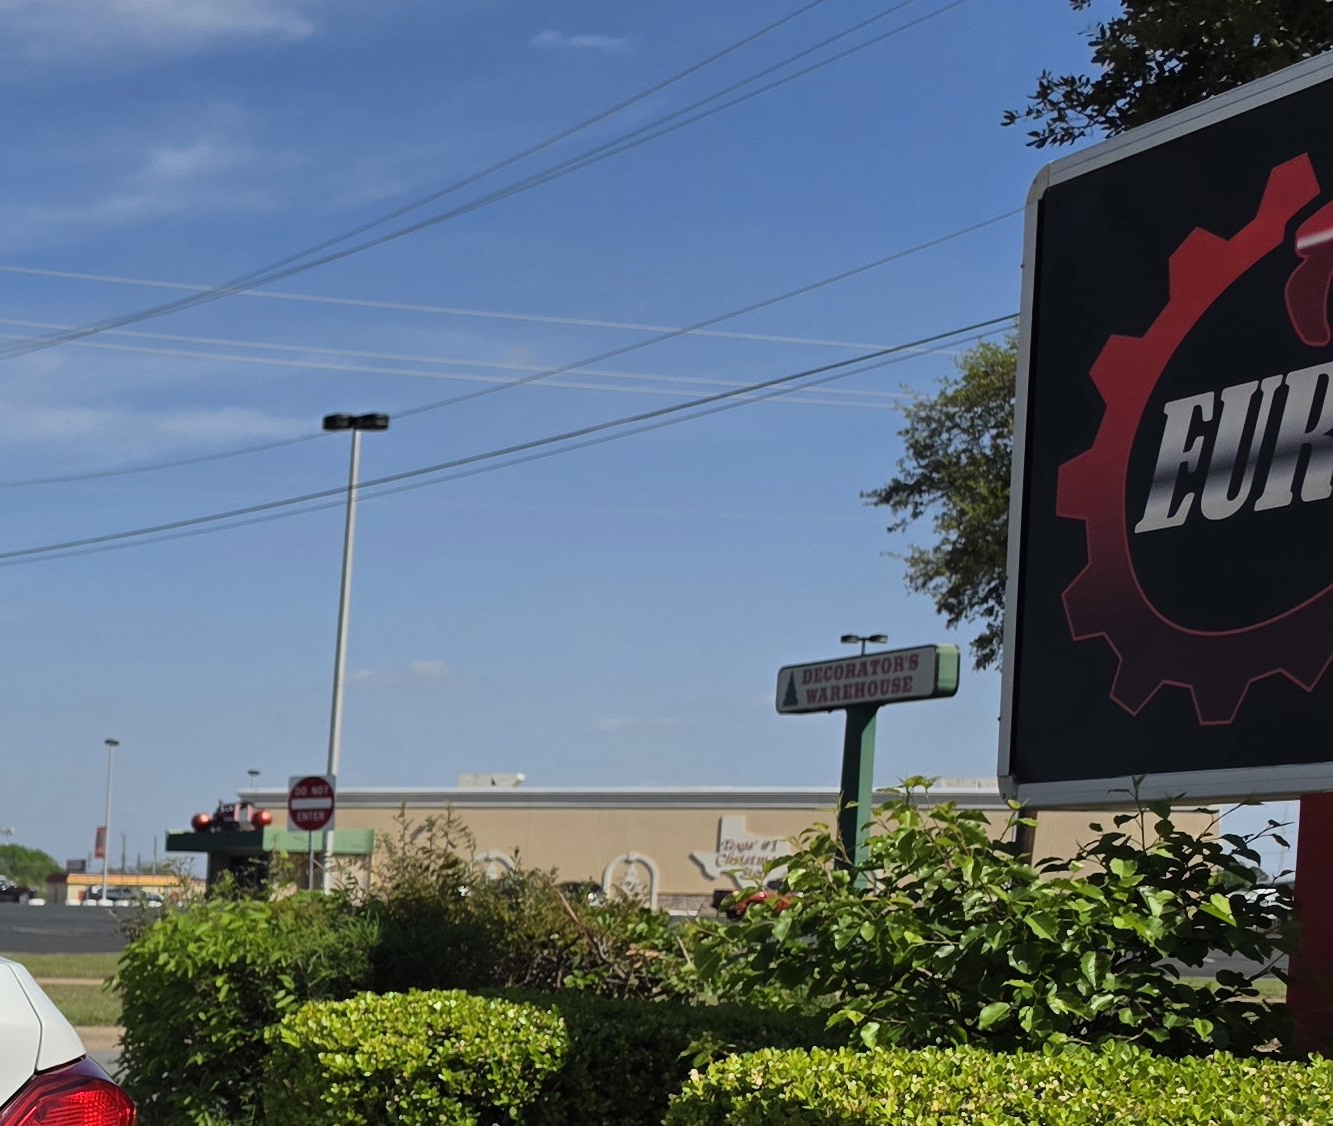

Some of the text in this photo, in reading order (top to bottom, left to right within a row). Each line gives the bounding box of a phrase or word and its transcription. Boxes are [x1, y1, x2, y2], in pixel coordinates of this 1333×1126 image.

[801, 653, 919, 686] DECORATOR'S
[806, 675, 913, 705] WAREHOUSE
[294, 785, 329, 797] DO NOT
[296, 811, 326, 822] ENTER
